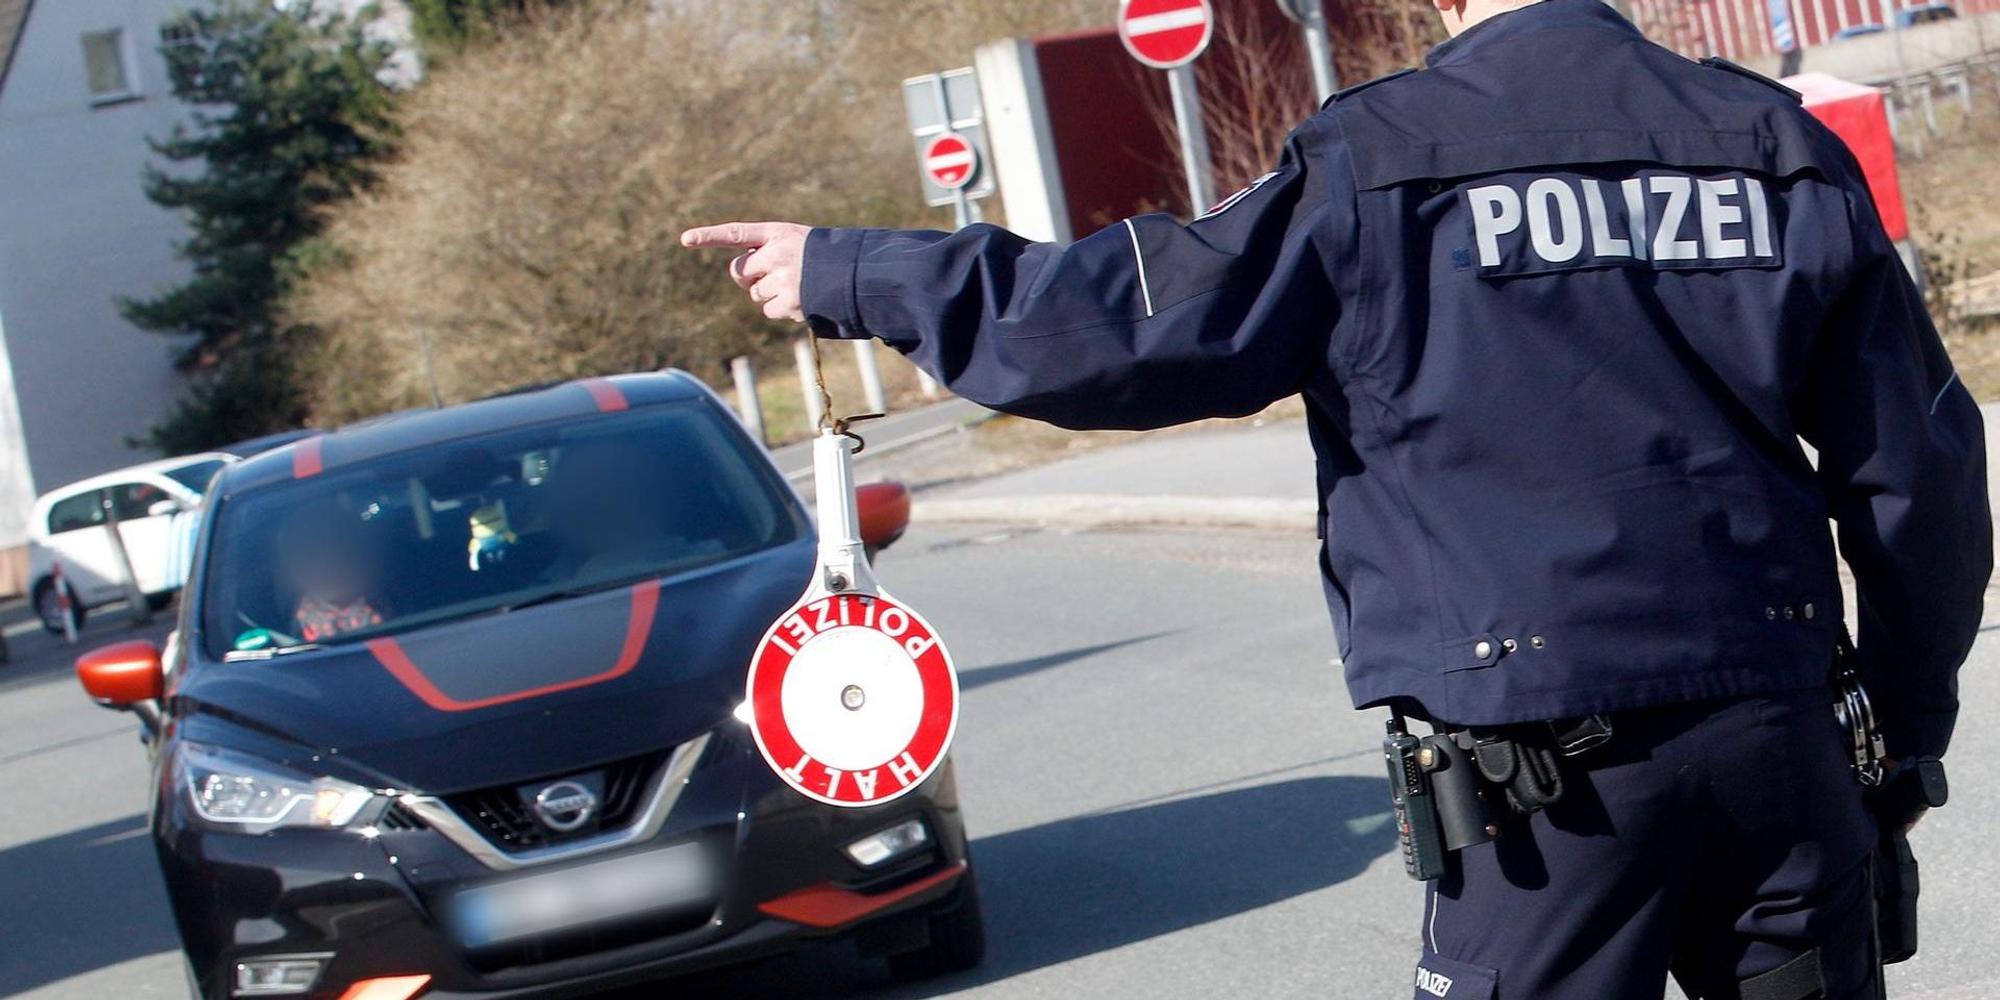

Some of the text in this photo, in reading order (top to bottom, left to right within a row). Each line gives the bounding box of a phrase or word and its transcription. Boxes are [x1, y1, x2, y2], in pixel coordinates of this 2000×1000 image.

[1467, 177, 1774, 266] POLIZEI
[770, 597, 936, 660] POLIZEI
[783, 751, 922, 799] HALT
